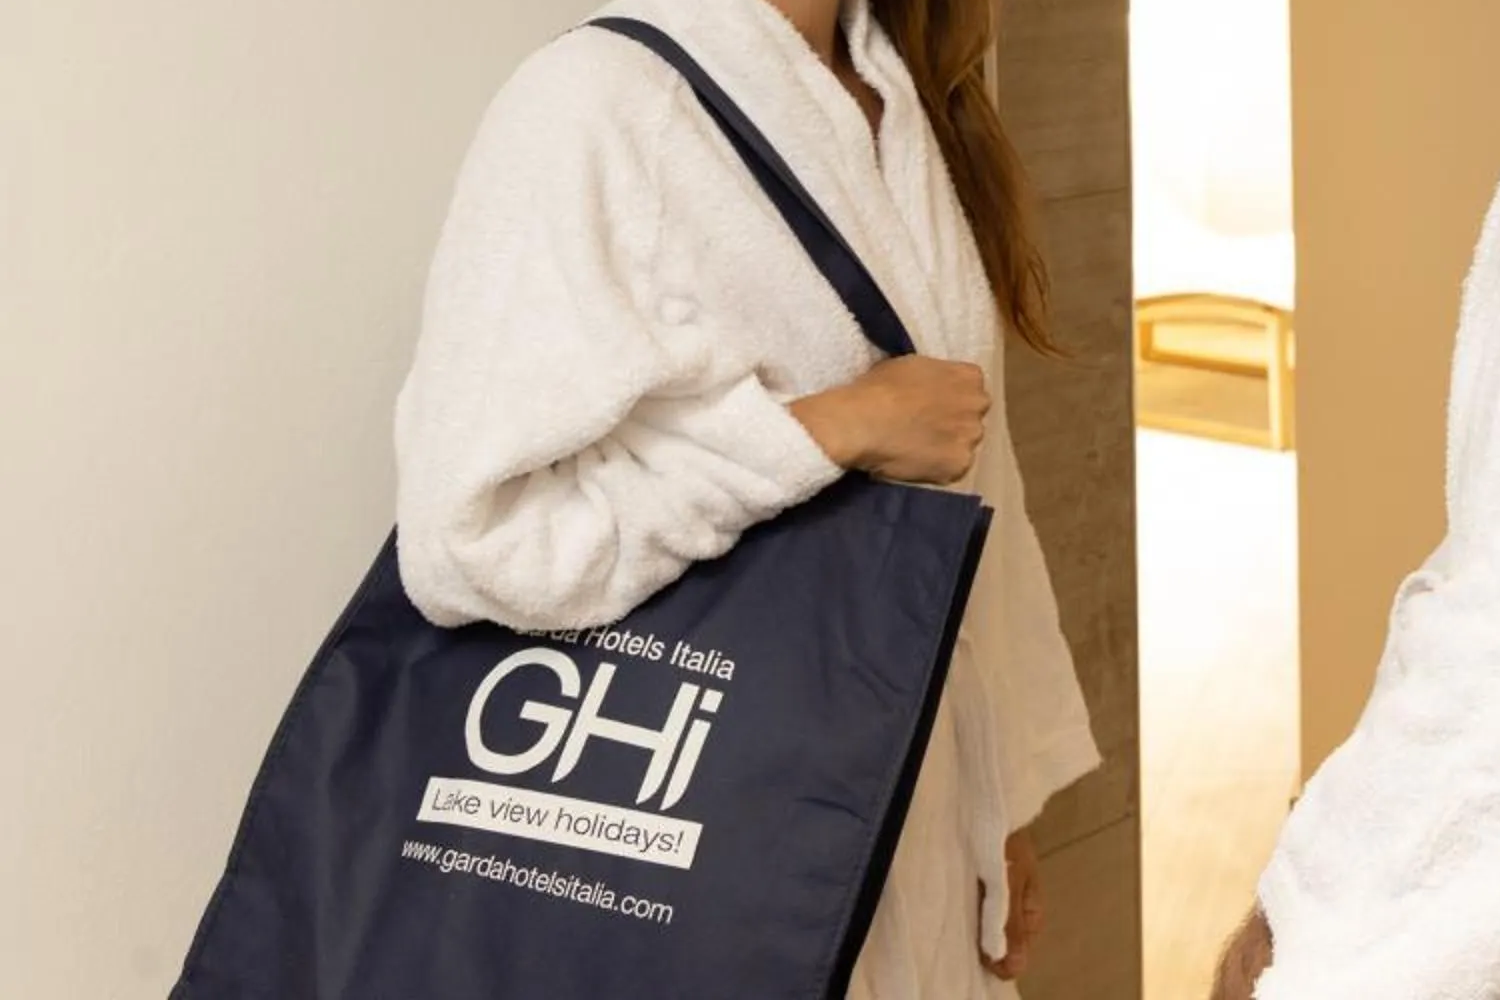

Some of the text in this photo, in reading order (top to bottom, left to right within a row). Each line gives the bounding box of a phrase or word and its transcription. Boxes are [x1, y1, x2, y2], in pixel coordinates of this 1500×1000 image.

[584, 624, 665, 661] Hotels
[669, 640, 735, 681] Italia
[465, 647, 724, 811] GHi
[431, 788, 685, 857] Lake view holidays!
[401, 839, 673, 924] www.gardahotelsitalia.com
